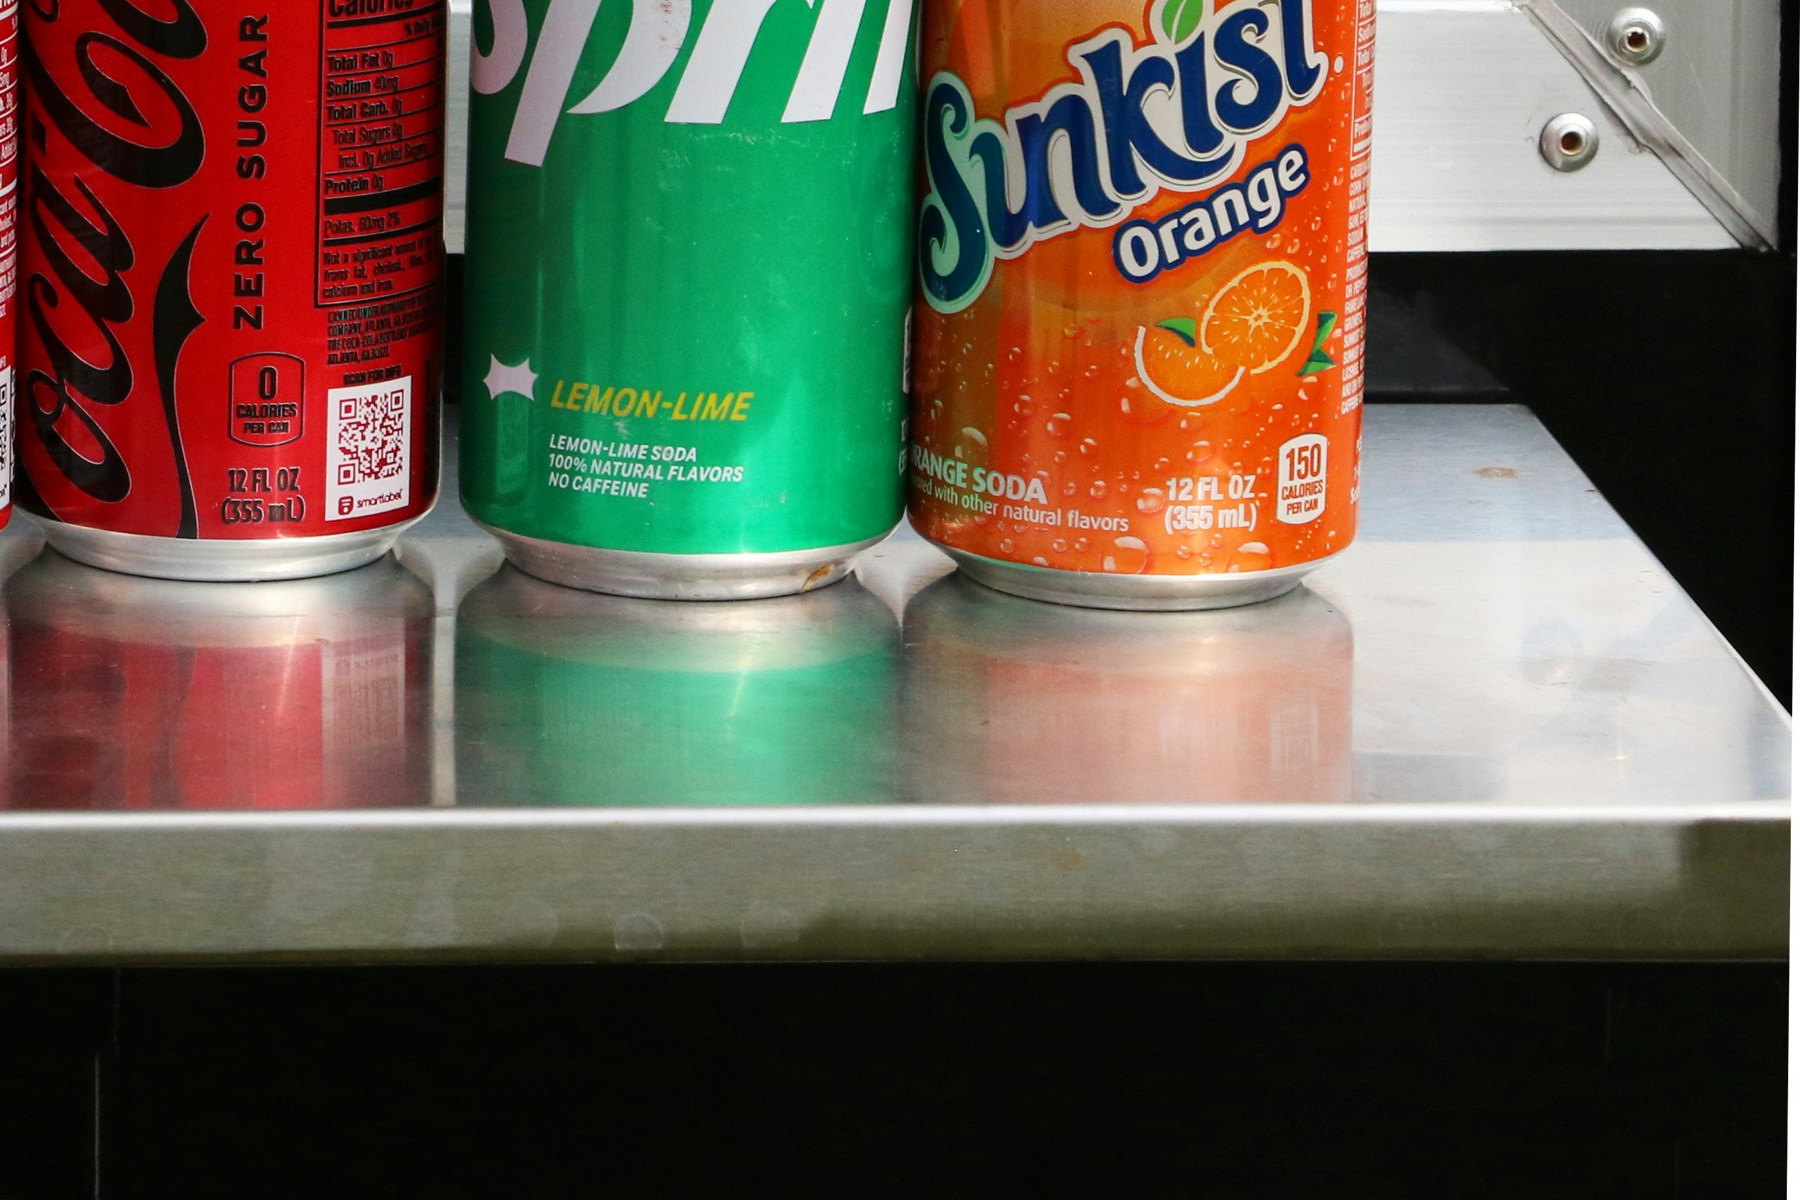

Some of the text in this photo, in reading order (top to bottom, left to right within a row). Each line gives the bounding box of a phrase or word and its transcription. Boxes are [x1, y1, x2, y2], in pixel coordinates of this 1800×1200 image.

[234, 13, 269, 330] ZERO SUGAR
[1116, 146, 1308, 281] Orange
[259, 365, 278, 400] 0
[236, 402, 298, 419] CALORIES
[550, 379, 756, 421] LEMON-LIME
[243, 420, 290, 434] PER CAN
[548, 433, 698, 463] LEMON-LIME SODA
[1286, 443, 1321, 481] 150
[227, 466, 301, 492] 12 FL OZ
[548, 453, 745, 482] 100% NATURAL FLAVORS
[548, 471, 649, 498] NO CAFFEINE
[972, 466, 1048, 505] SODA
[1166, 474, 1257, 501] 12 FL OZ
[1281, 480, 1324, 501] CALORIES
[221, 494, 306, 525] (355 mL)
[935, 484, 958, 506] with
[961, 492, 999, 516] other
[1003, 502, 1061, 526] natural
[1067, 509, 1130, 532] flavors
[1164, 502, 1257, 535] (355 mL)
[1286, 498, 1319, 516] PER CAN
